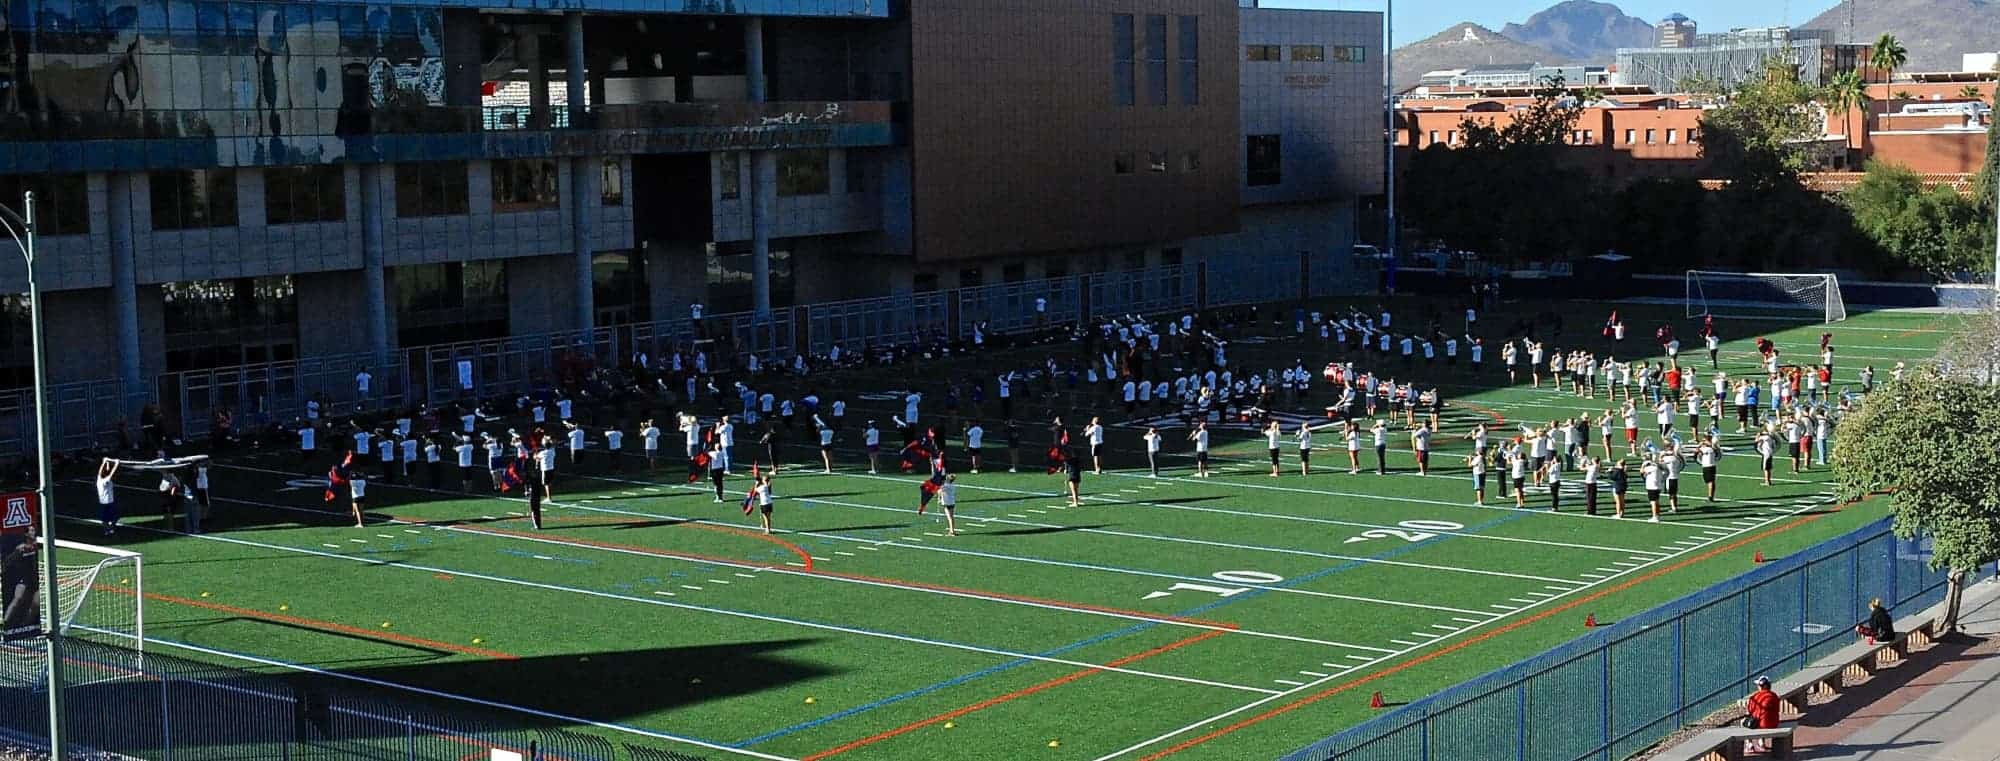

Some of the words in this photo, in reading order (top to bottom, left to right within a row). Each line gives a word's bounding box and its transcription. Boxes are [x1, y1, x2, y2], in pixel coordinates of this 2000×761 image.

[3, 497, 32, 528] A
[1359, 520, 1464, 543] 20
[1167, 570, 1284, 598] 10
